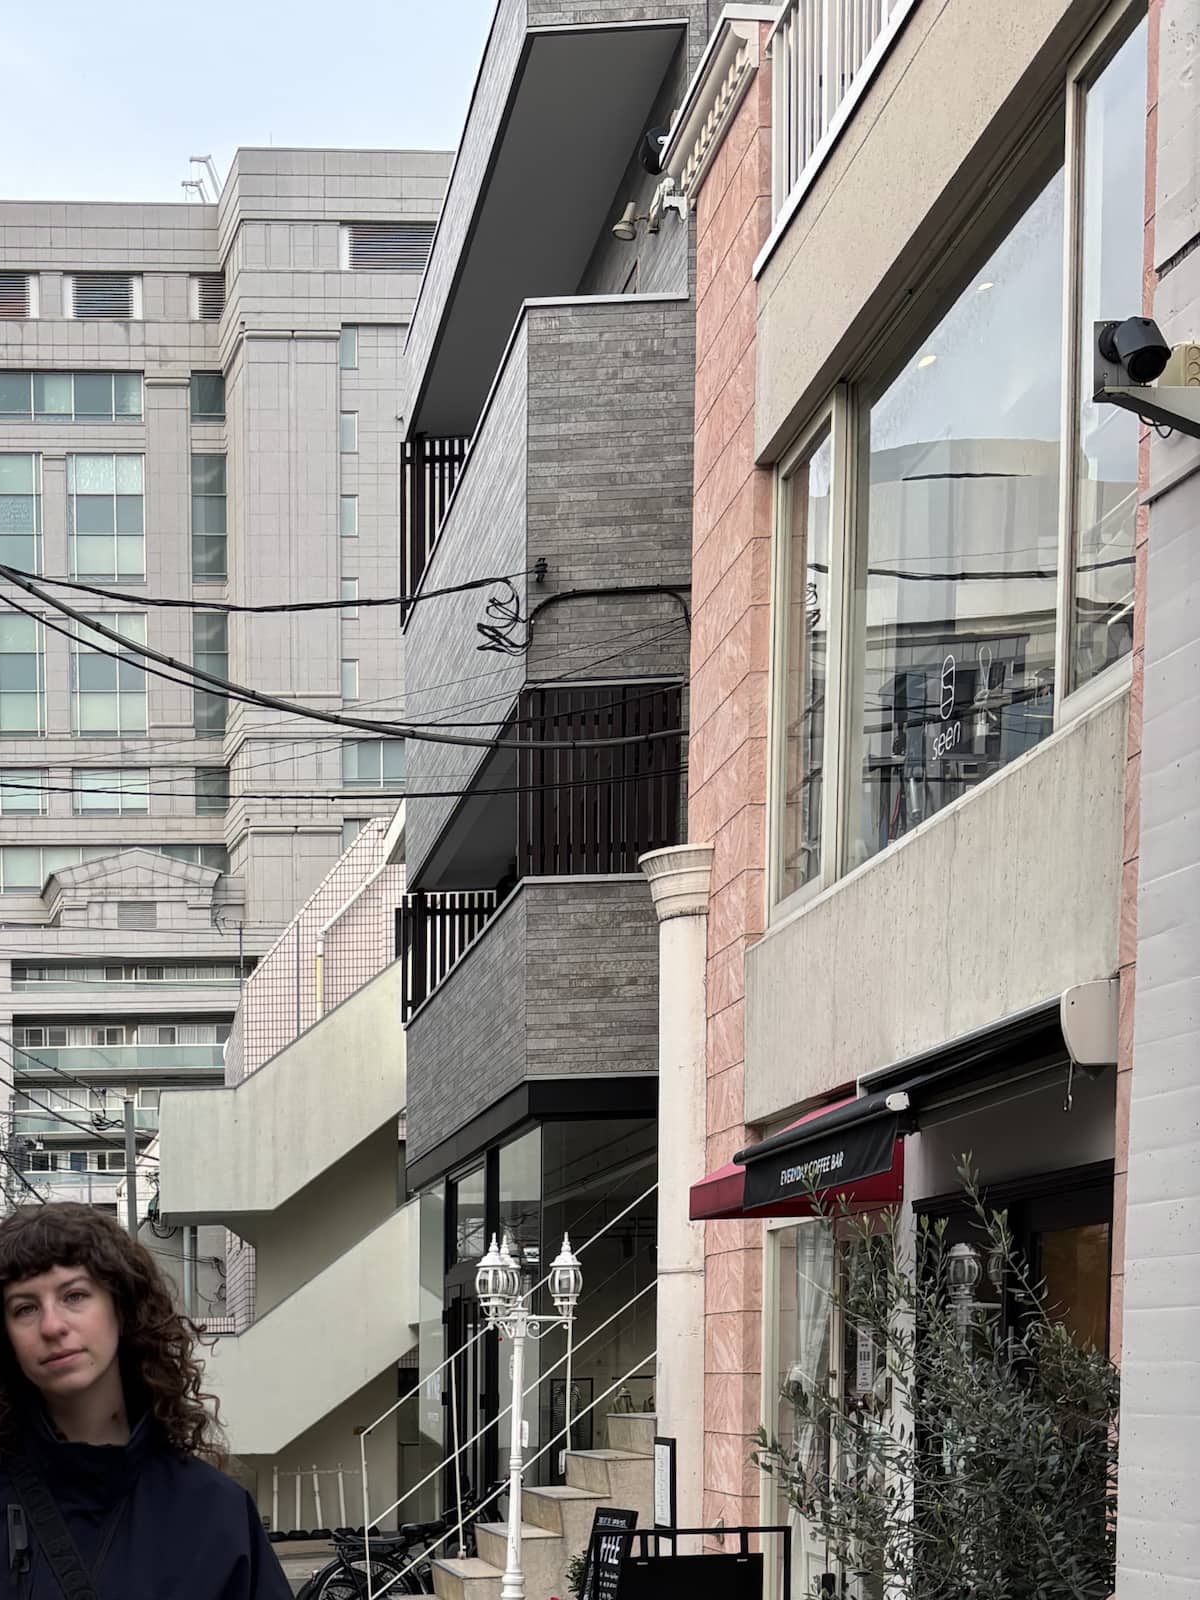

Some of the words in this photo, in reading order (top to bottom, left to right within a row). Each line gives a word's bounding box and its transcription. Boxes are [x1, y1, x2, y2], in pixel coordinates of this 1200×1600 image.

[932, 721, 961, 760] seen
[780, 1163, 808, 1186] EVERYDAY
[808, 1155, 831, 1176] COFFEE
[831, 1151, 844, 1170] BAR
